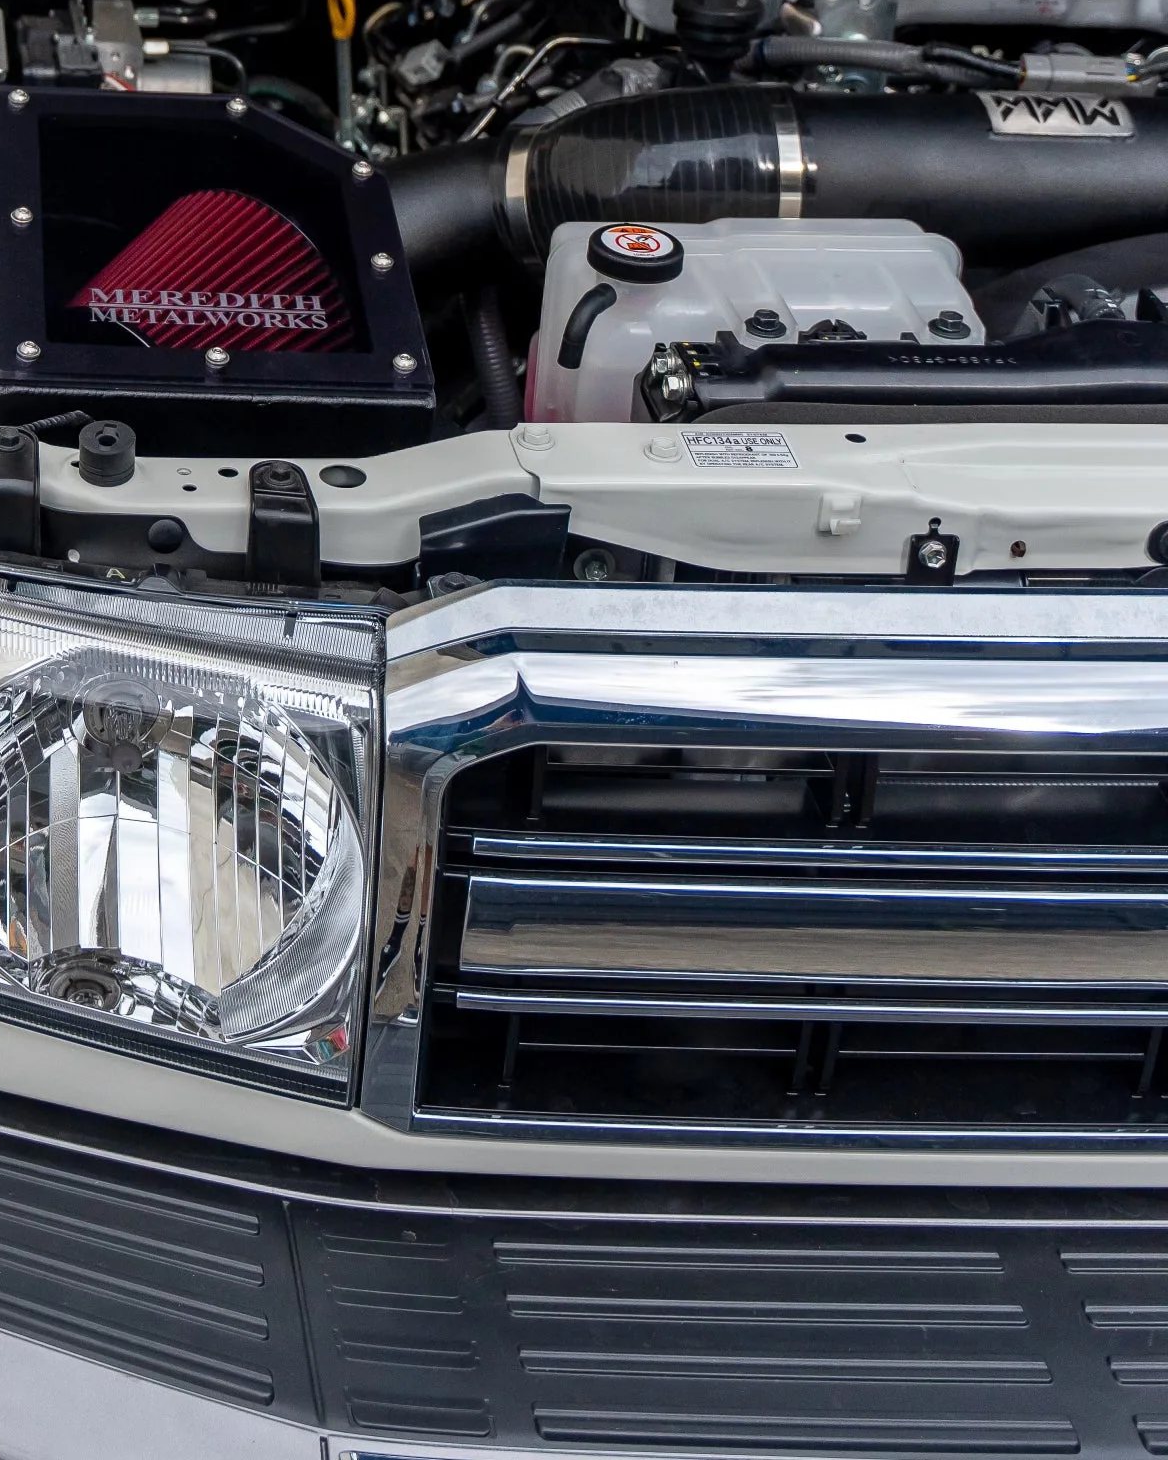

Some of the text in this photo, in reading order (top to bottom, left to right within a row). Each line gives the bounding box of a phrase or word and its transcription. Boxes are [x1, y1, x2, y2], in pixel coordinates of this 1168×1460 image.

[89, 288, 324, 310] MEREDITH
[89, 308, 329, 329] METALWORKS
[742, 437, 759, 445] USE
[759, 437, 782, 445] ONLY
